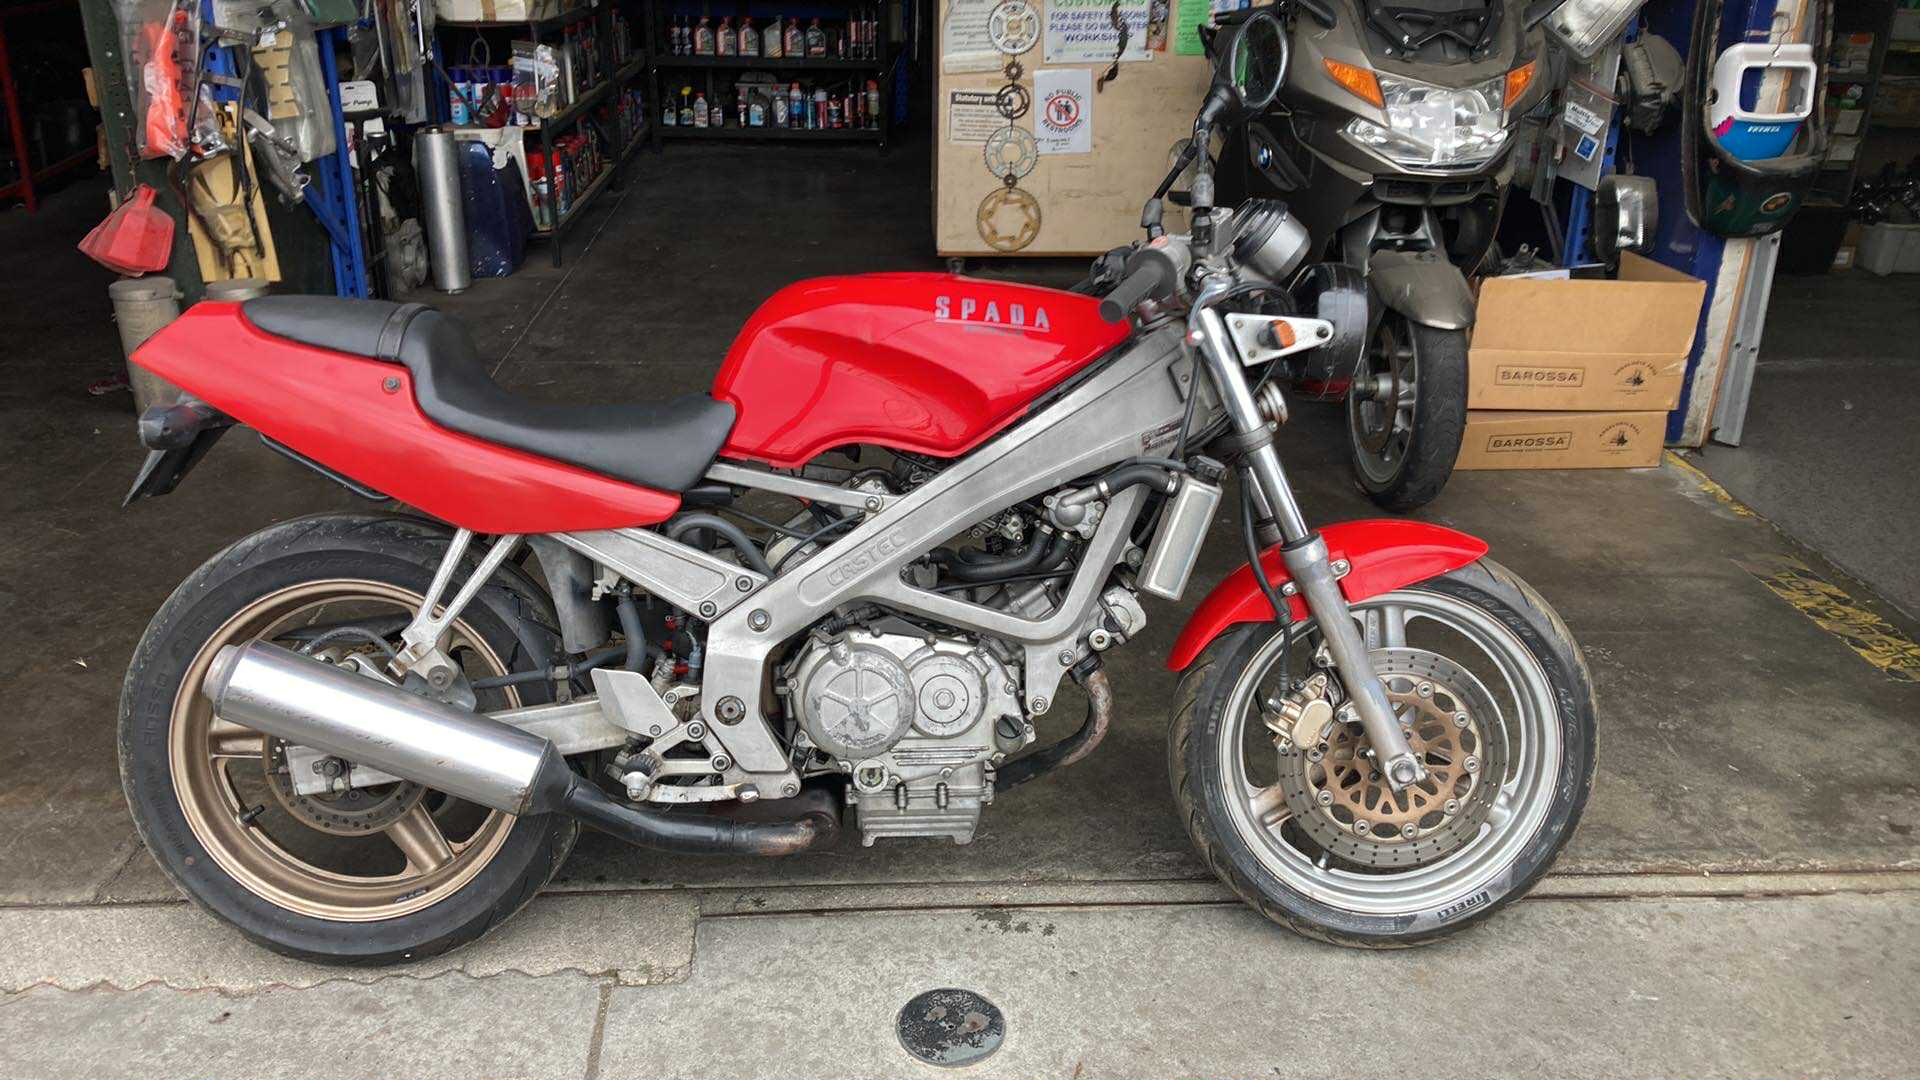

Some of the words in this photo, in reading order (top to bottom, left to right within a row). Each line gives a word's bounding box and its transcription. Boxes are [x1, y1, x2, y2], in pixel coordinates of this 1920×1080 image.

[935, 295, 1050, 329] SPADA
[1501, 371, 1579, 382] BAROSSA
[1493, 437, 1566, 448] BAROSSA
[1436, 890, 1492, 922] PIRELLI
